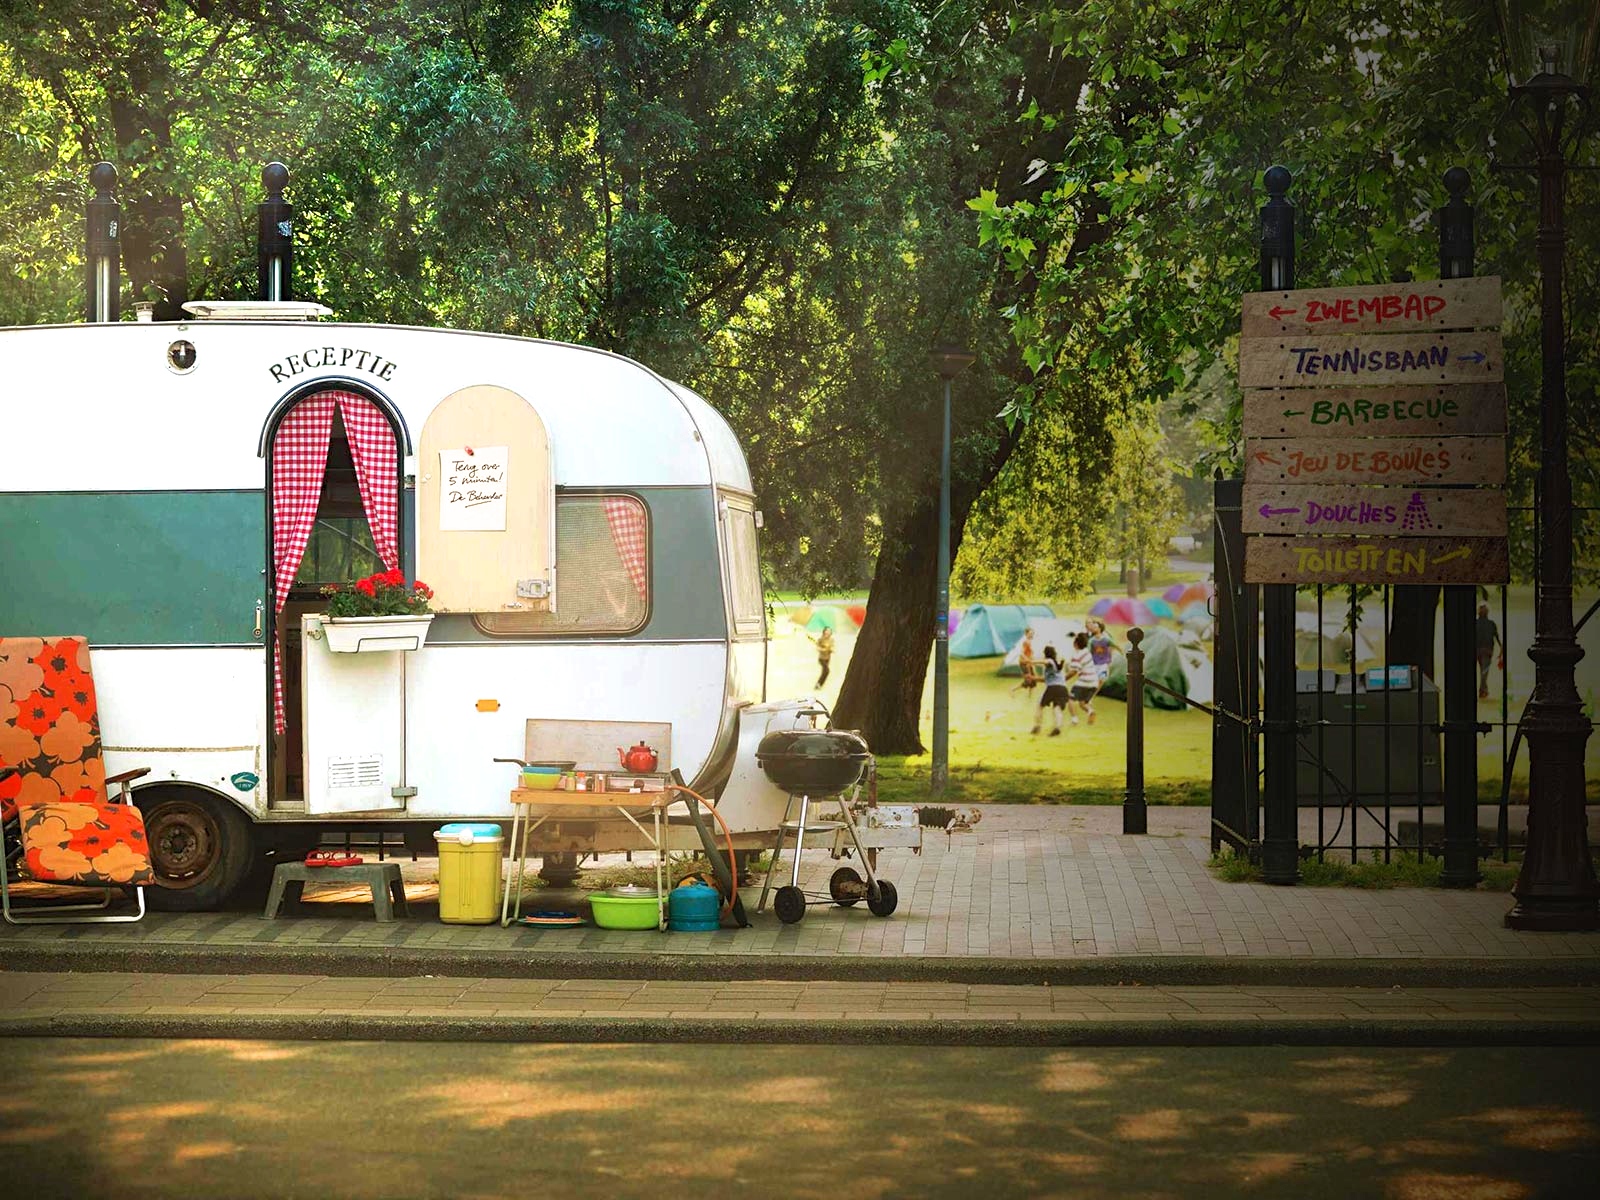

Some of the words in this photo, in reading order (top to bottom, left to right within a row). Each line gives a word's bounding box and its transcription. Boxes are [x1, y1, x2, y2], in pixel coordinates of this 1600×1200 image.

[1305, 294, 1447, 323] ZWEMBAD
[269, 347, 397, 383] RECEPTIE
[1336, 452, 1365, 472] DE
[449, 476, 458, 486] 5
[449, 491, 466, 503] De
[1305, 501, 1397, 524] DOUCHES
